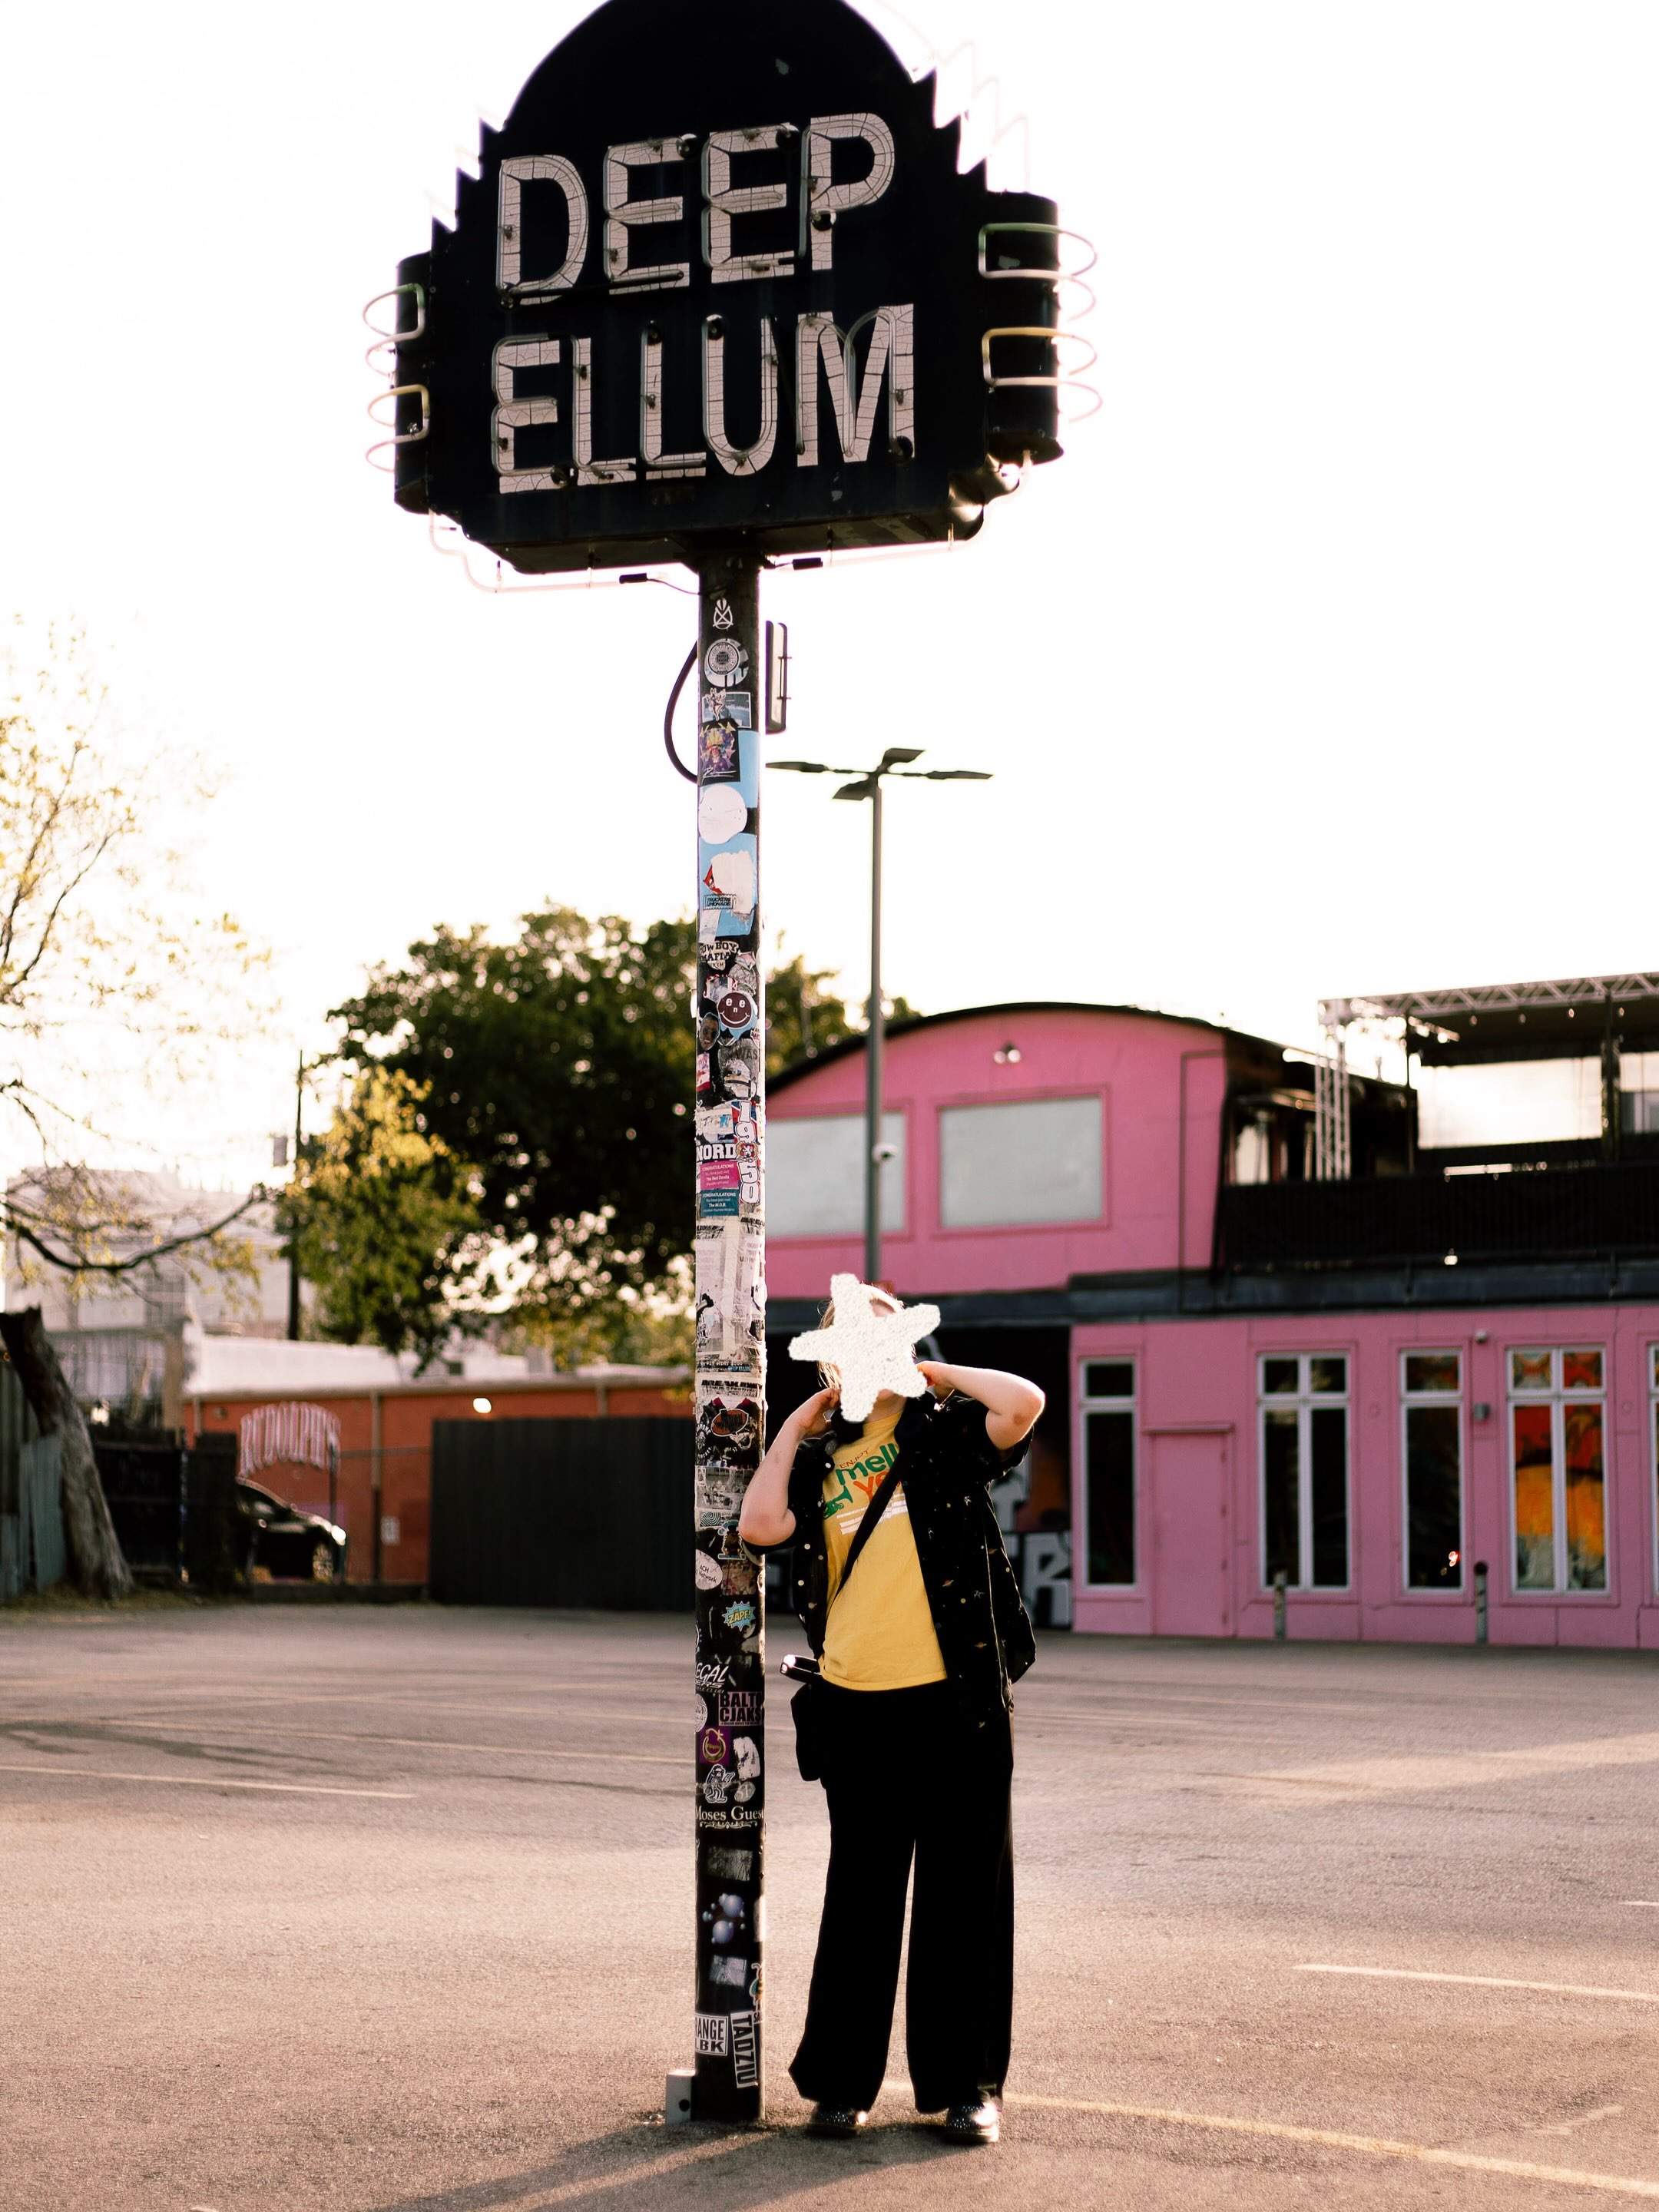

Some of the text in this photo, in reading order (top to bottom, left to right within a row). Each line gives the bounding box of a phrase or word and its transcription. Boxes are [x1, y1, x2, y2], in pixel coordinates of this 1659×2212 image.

[496, 113, 895, 304] DEEP
[492, 303, 914, 493] ELLUM
[835, 1443, 899, 1485] mell
[839, 1448, 869, 1469] ENJOY
